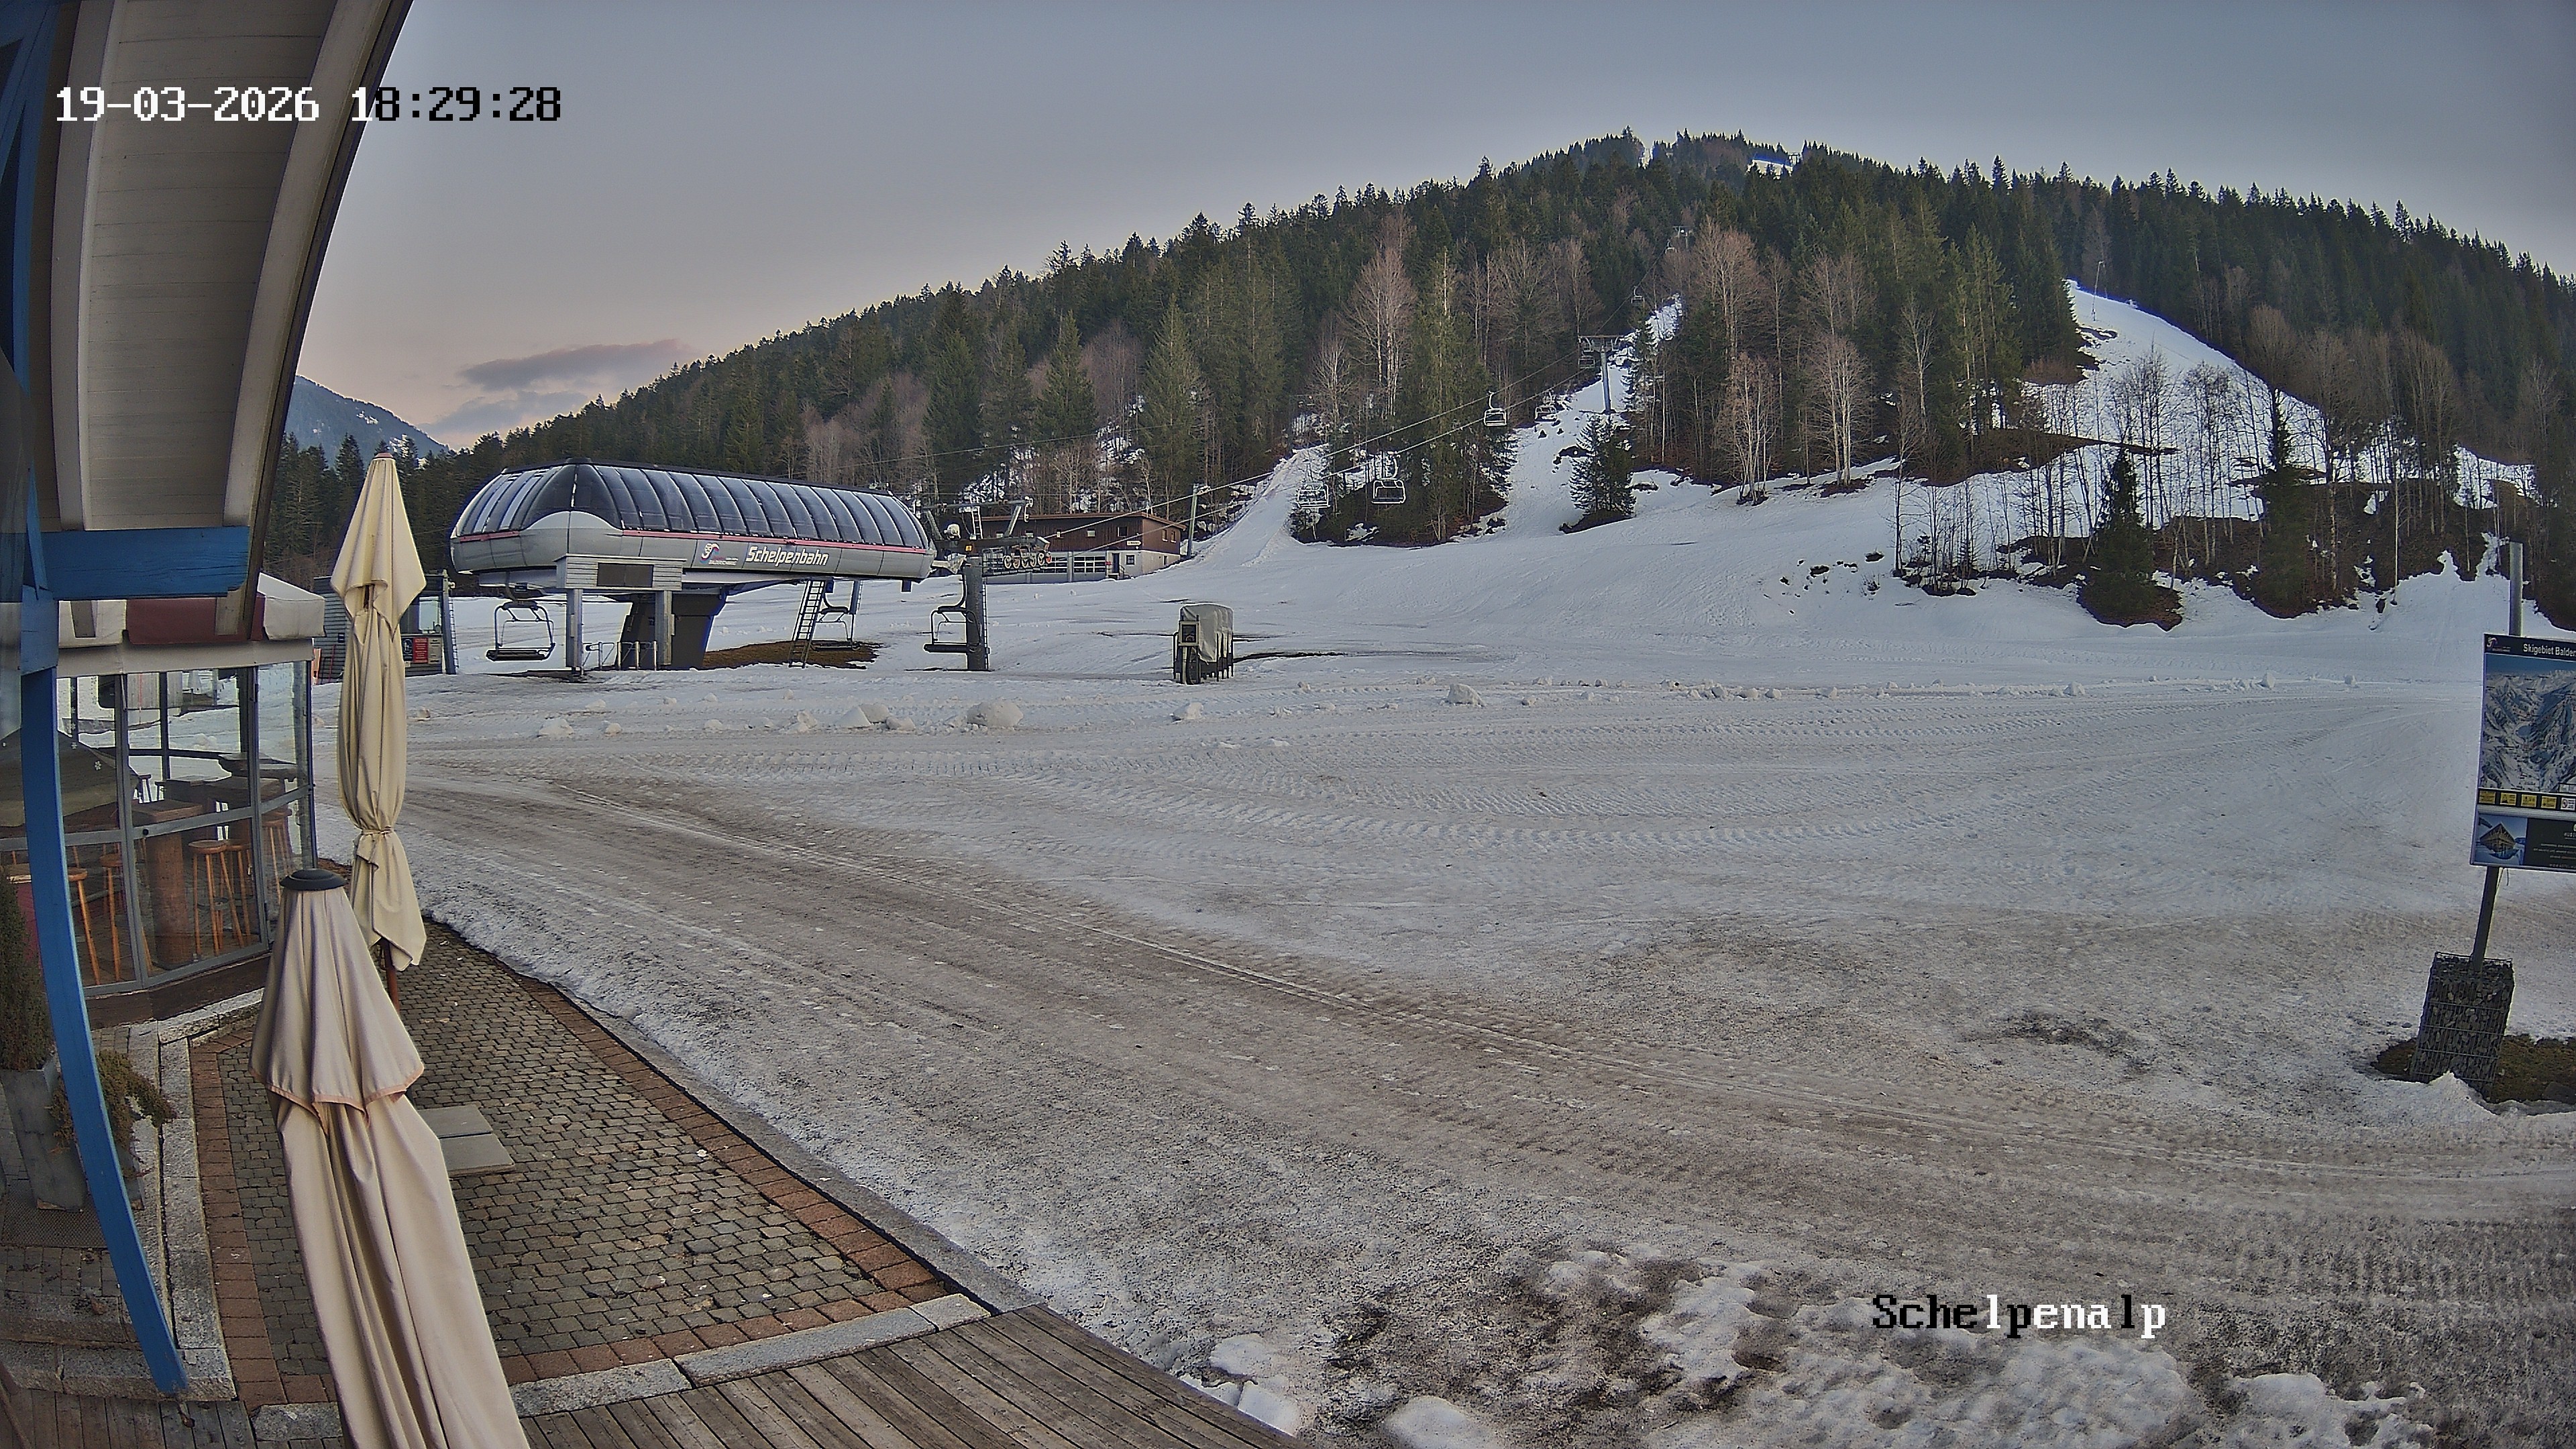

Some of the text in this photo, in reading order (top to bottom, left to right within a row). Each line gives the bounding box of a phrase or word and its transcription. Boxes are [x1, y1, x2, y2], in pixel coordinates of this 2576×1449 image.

[746, 546, 829, 567] Schelpenbahn
[2523, 644, 2554, 655] Skigebiet
[2555, 647, 2576, 657] Balder
